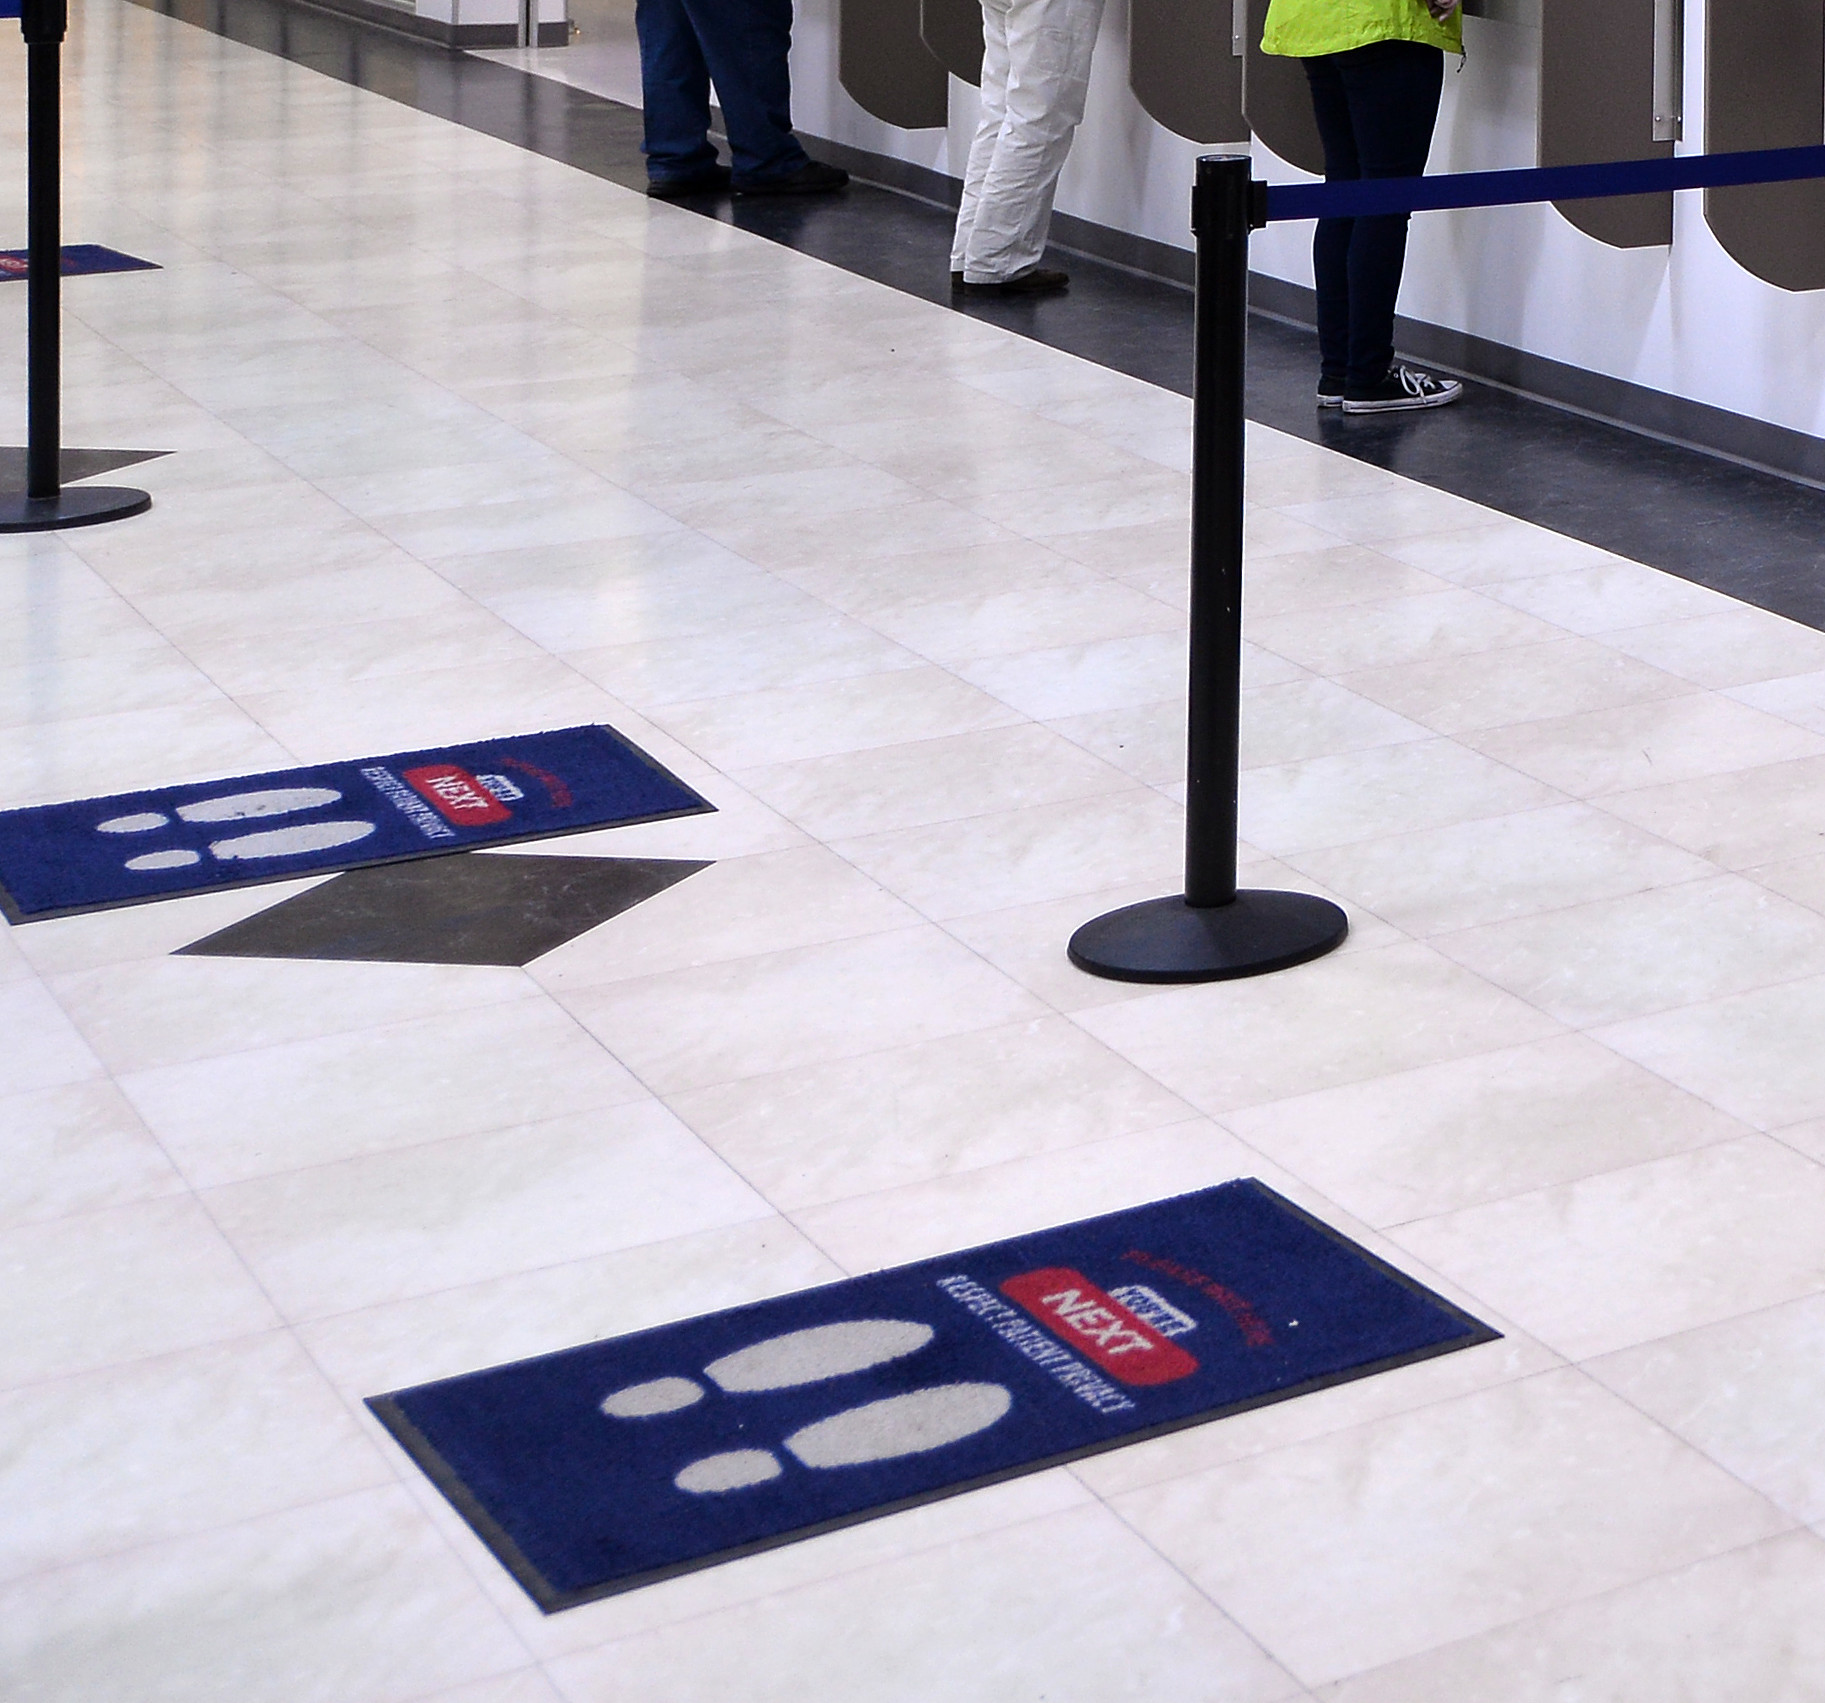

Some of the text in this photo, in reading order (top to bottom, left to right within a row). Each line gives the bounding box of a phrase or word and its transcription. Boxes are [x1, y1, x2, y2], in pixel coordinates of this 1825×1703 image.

[425, 774, 489, 810] NEXT
[936, 1275, 1135, 1414] RESPECT PATIENT PRIVACY
[1041, 1288, 1155, 1356] NEXT
